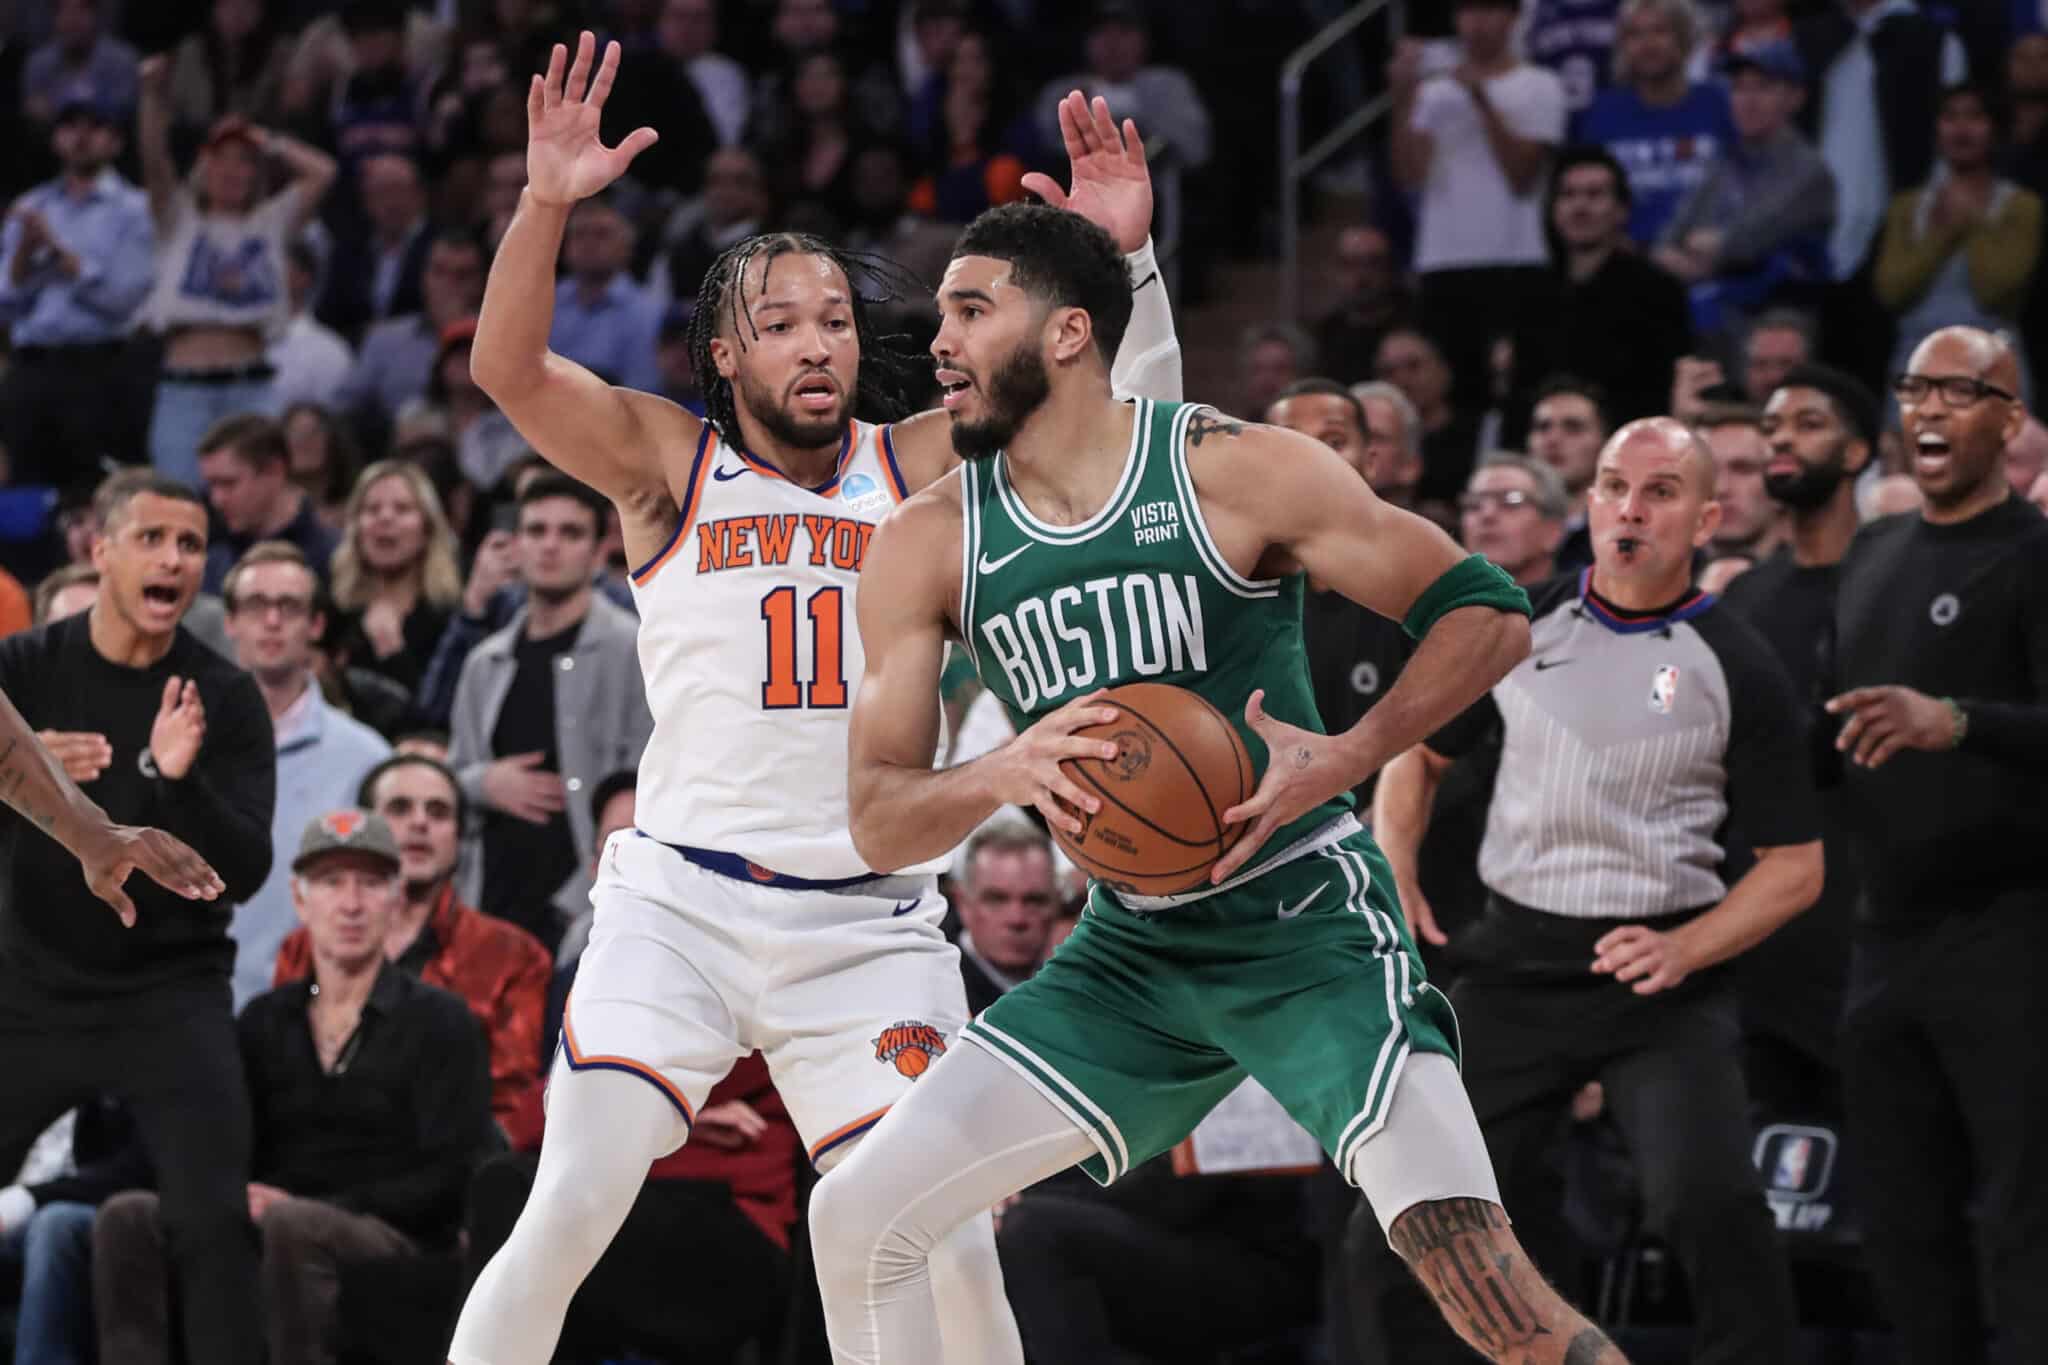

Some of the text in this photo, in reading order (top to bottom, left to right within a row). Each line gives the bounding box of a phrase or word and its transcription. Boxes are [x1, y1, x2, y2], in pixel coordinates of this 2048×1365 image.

[1131, 502, 1178, 529] VISTA
[1134, 523, 1179, 547] PRINT
[696, 514, 799, 575] NEW
[761, 585, 848, 710] 11
[981, 573, 1207, 713] BOSTON
[876, 1025, 947, 1058] KNICKS
